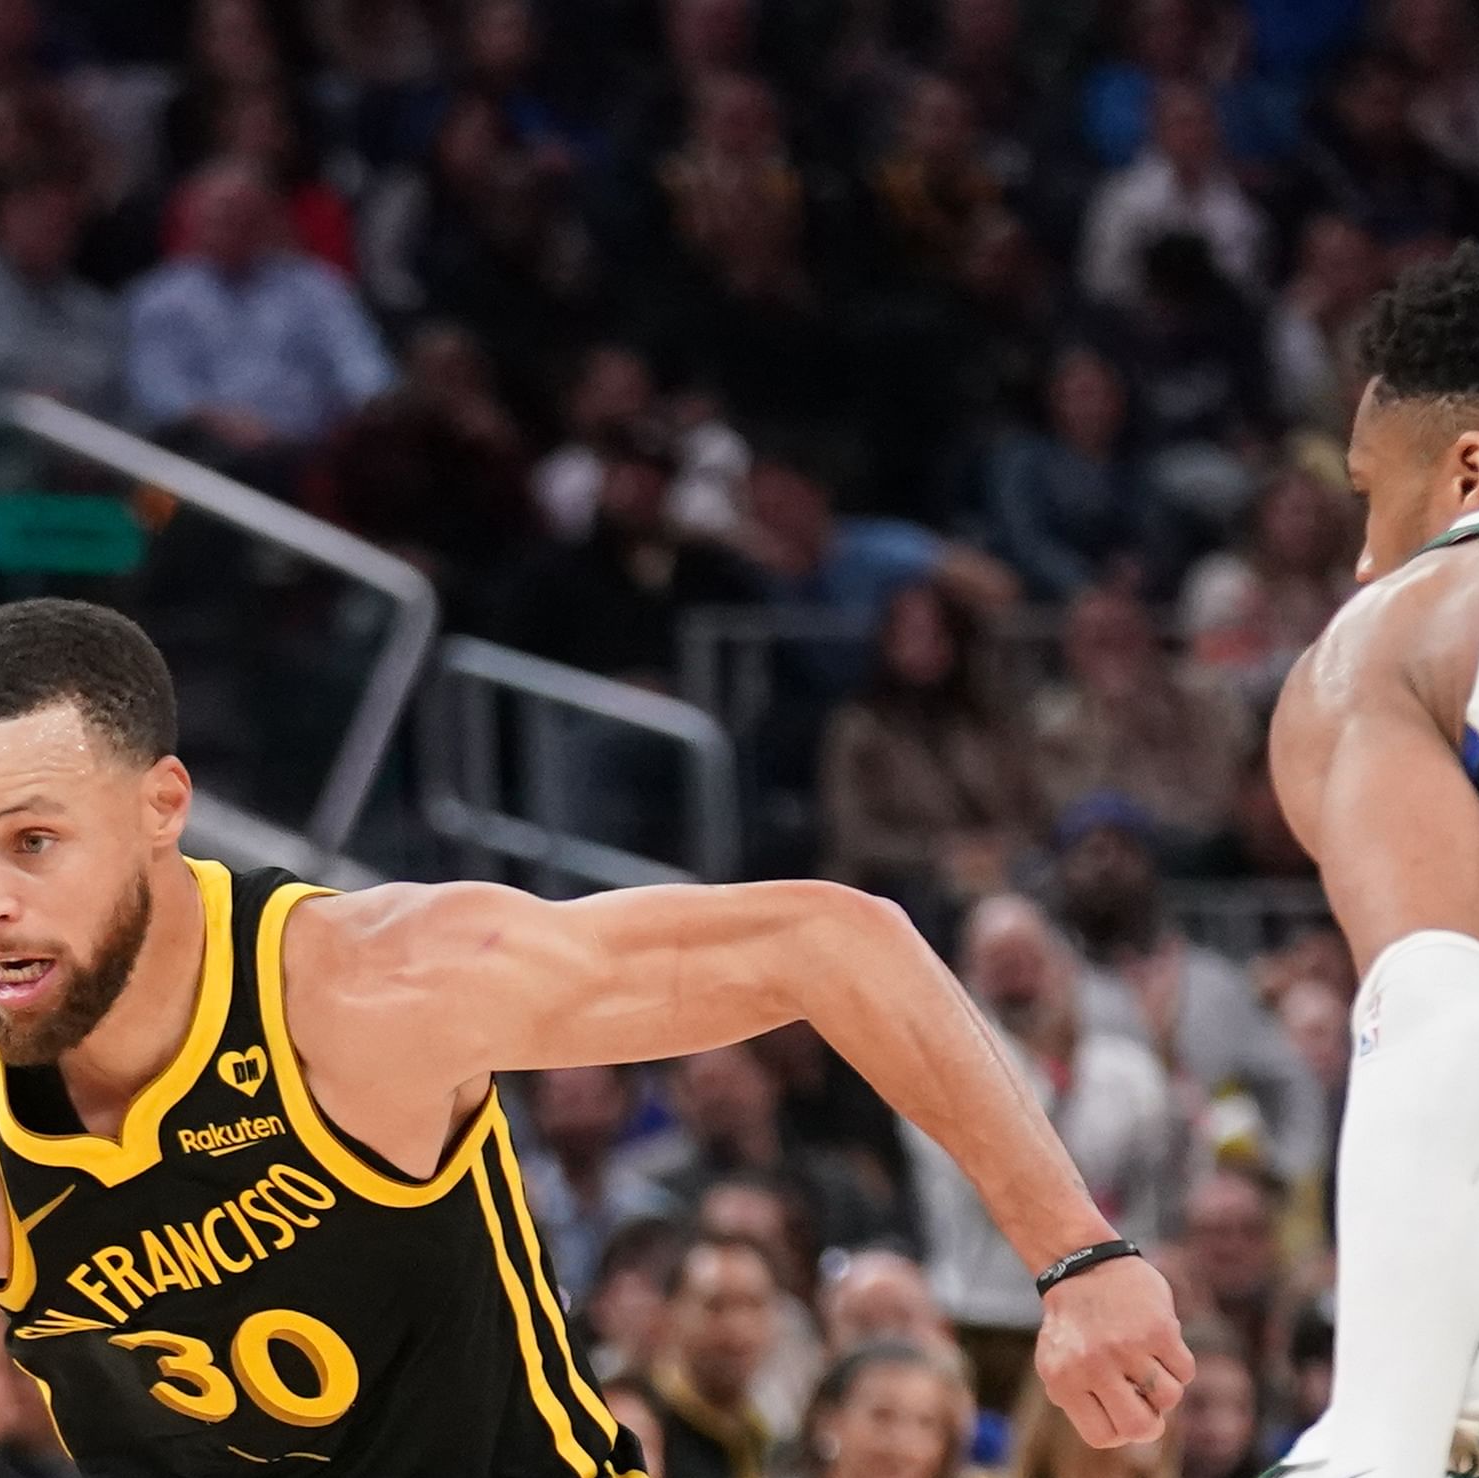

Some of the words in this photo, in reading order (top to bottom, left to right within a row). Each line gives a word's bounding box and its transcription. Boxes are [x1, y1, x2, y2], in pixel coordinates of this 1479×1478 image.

[177, 1115, 287, 1154] Rakuten
[66, 1163, 337, 1324] FRANCISCO
[107, 1308, 360, 1428] 30
